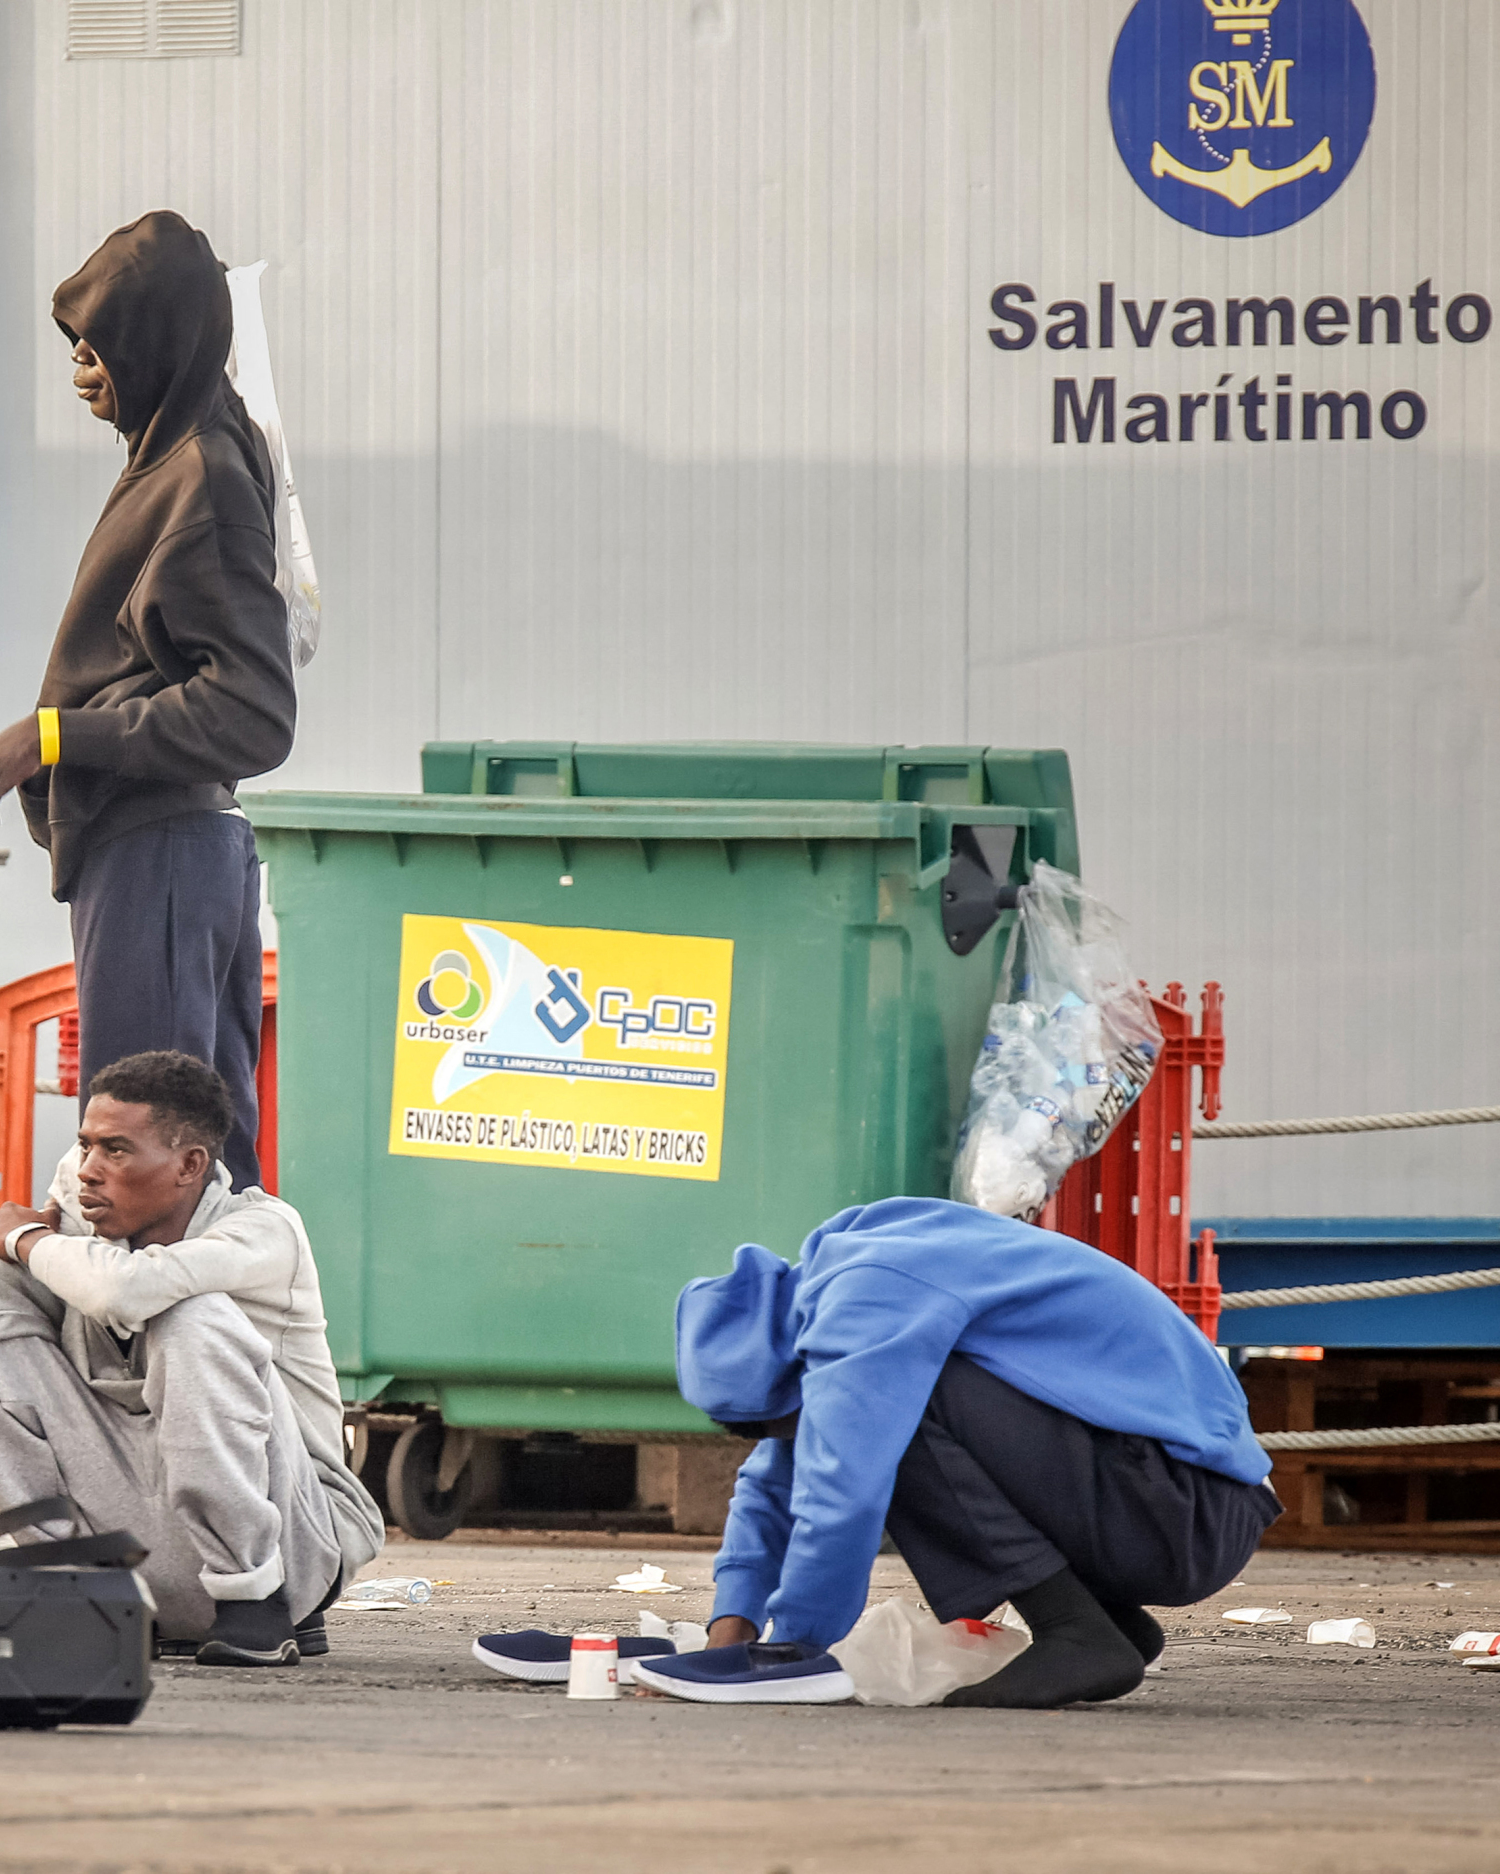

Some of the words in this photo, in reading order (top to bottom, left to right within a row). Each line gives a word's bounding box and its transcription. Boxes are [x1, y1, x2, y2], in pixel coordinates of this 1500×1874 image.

[1188, 59, 1295, 131] SM
[988, 277, 1492, 350] Salvamento
[1052, 373, 1428, 443] Marítimo
[406, 1020, 489, 1043] urbaser
[503, 1058, 565, 1073] LIMPIEZA
[567, 1062, 628, 1078] PUERTOS
[629, 1068, 649, 1079] DE
[651, 1070, 714, 1084] TENERIFE
[406, 1111, 473, 1143] ENVASES
[478, 1117, 497, 1145] DE
[500, 1112, 578, 1160] PLÁSTICO,
[582, 1125, 629, 1157] LATAS
[635, 1129, 645, 1158] Y
[649, 1131, 705, 1163] BRICKS
